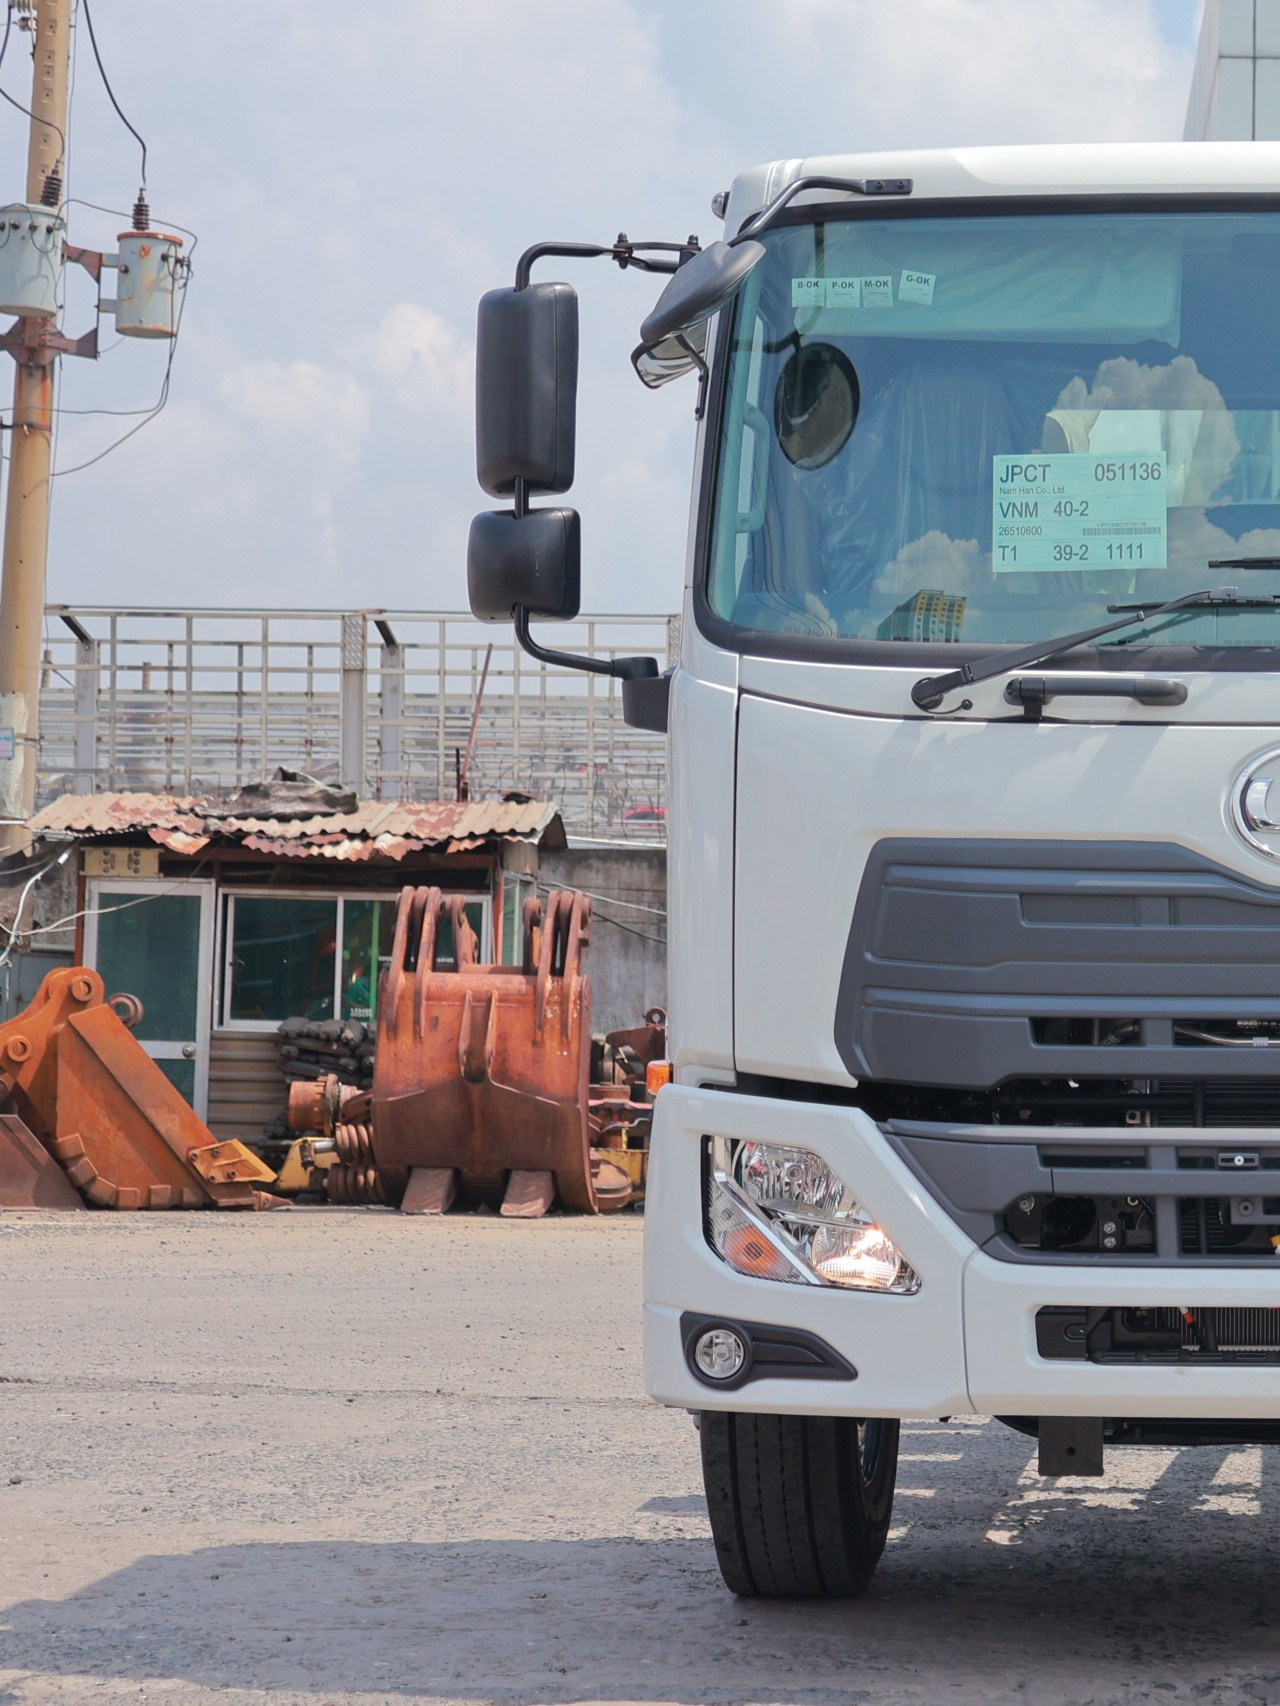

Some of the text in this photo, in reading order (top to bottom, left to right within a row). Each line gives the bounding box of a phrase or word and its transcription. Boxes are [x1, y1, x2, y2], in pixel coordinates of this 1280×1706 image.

[797, 280, 820, 289] B-OK
[832, 281, 855, 289] P-OK
[864, 280, 890, 288] M-OK
[906, 274, 931, 286] G-OK
[1000, 462, 1162, 483] JPCT 051136
[999, 487, 1016, 495] Nam
[1018, 487, 1035, 495] Han
[1052, 486, 1067, 494] Ltd.
[998, 501, 1089, 518] VNM 40-2
[998, 526, 1043, 536] 26510600
[998, 543, 1143, 561] T1 39-2 1111
